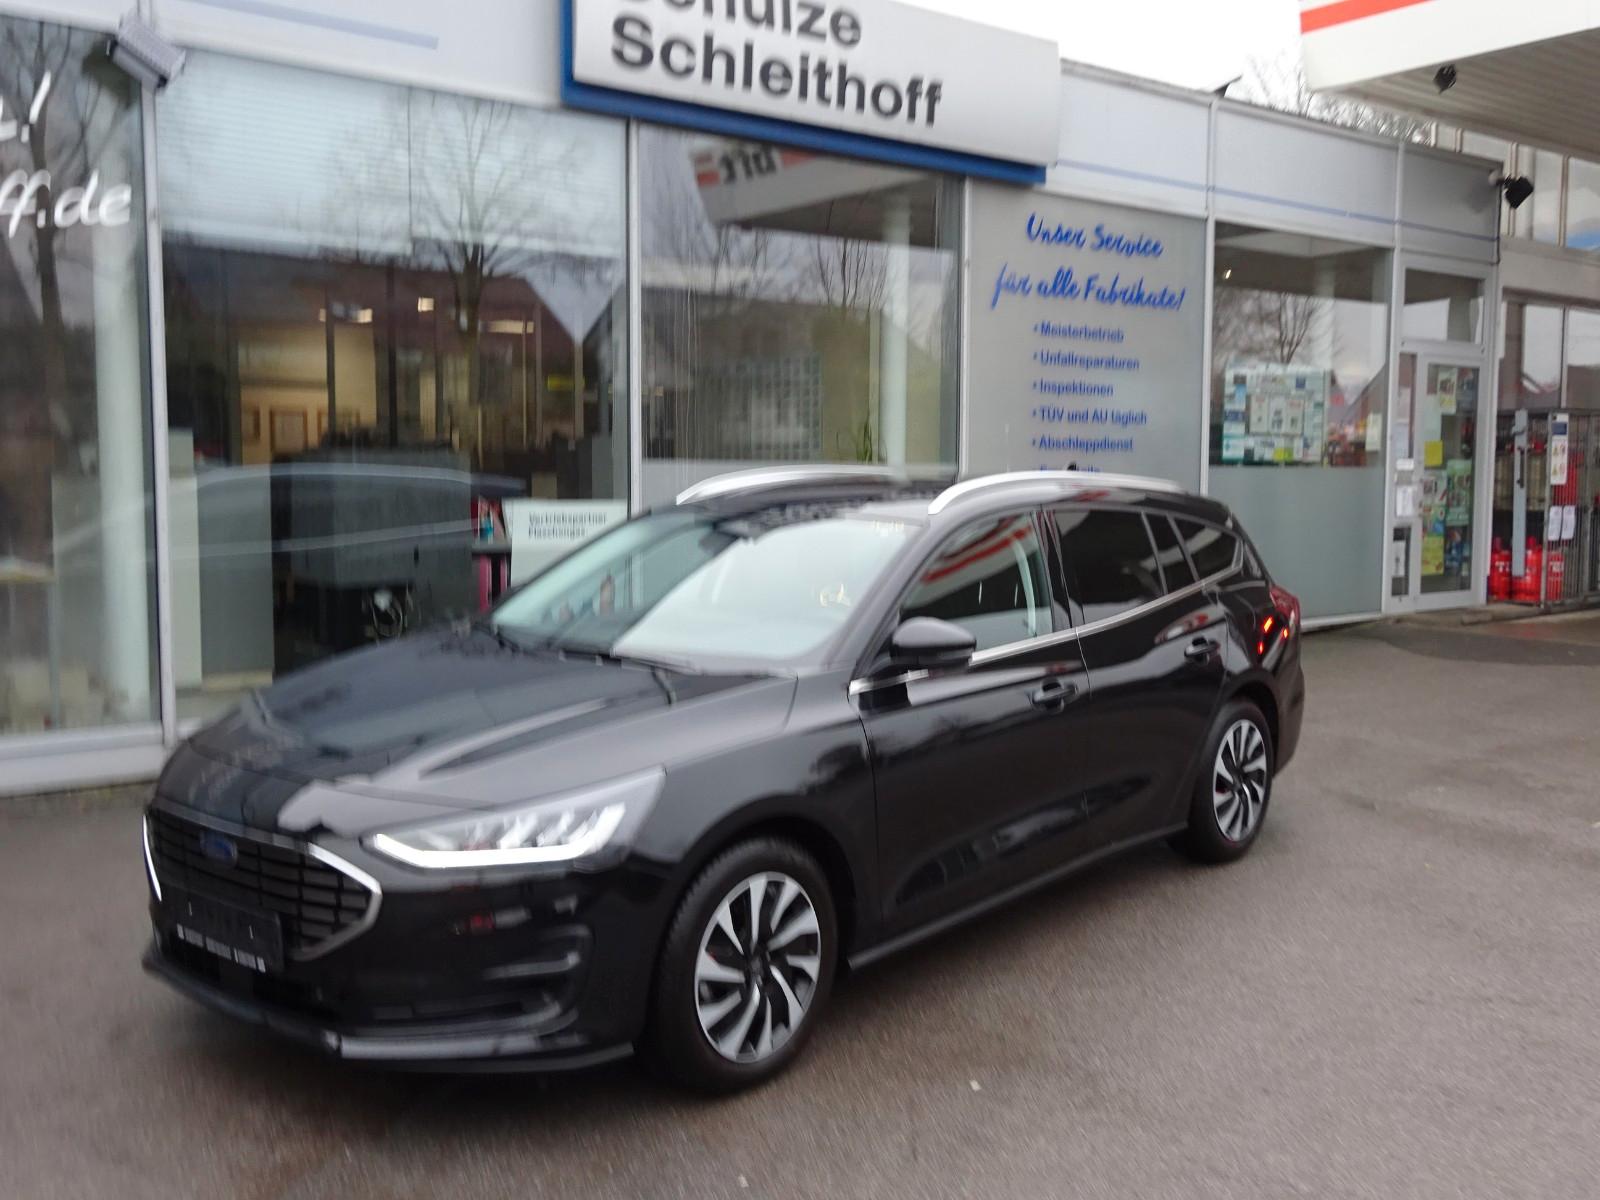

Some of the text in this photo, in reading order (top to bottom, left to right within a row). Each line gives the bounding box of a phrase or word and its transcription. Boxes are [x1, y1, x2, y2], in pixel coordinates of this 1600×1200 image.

[637, 0, 862, 48] ulze
[611, 12, 943, 128] Schleithoff
[1026, 212, 1164, 257] Unser Service
[991, 262, 1186, 311] für alle Fabrikate!
[1040, 320, 1124, 343] Meisterbetrieb
[1040, 348, 1140, 371] Unfallreparaturen
[1040, 378, 1114, 397] Inspektionen
[1040, 403, 1147, 428] TÜV und AU täglich
[1039, 434, 1134, 454] Abschleppdienst
